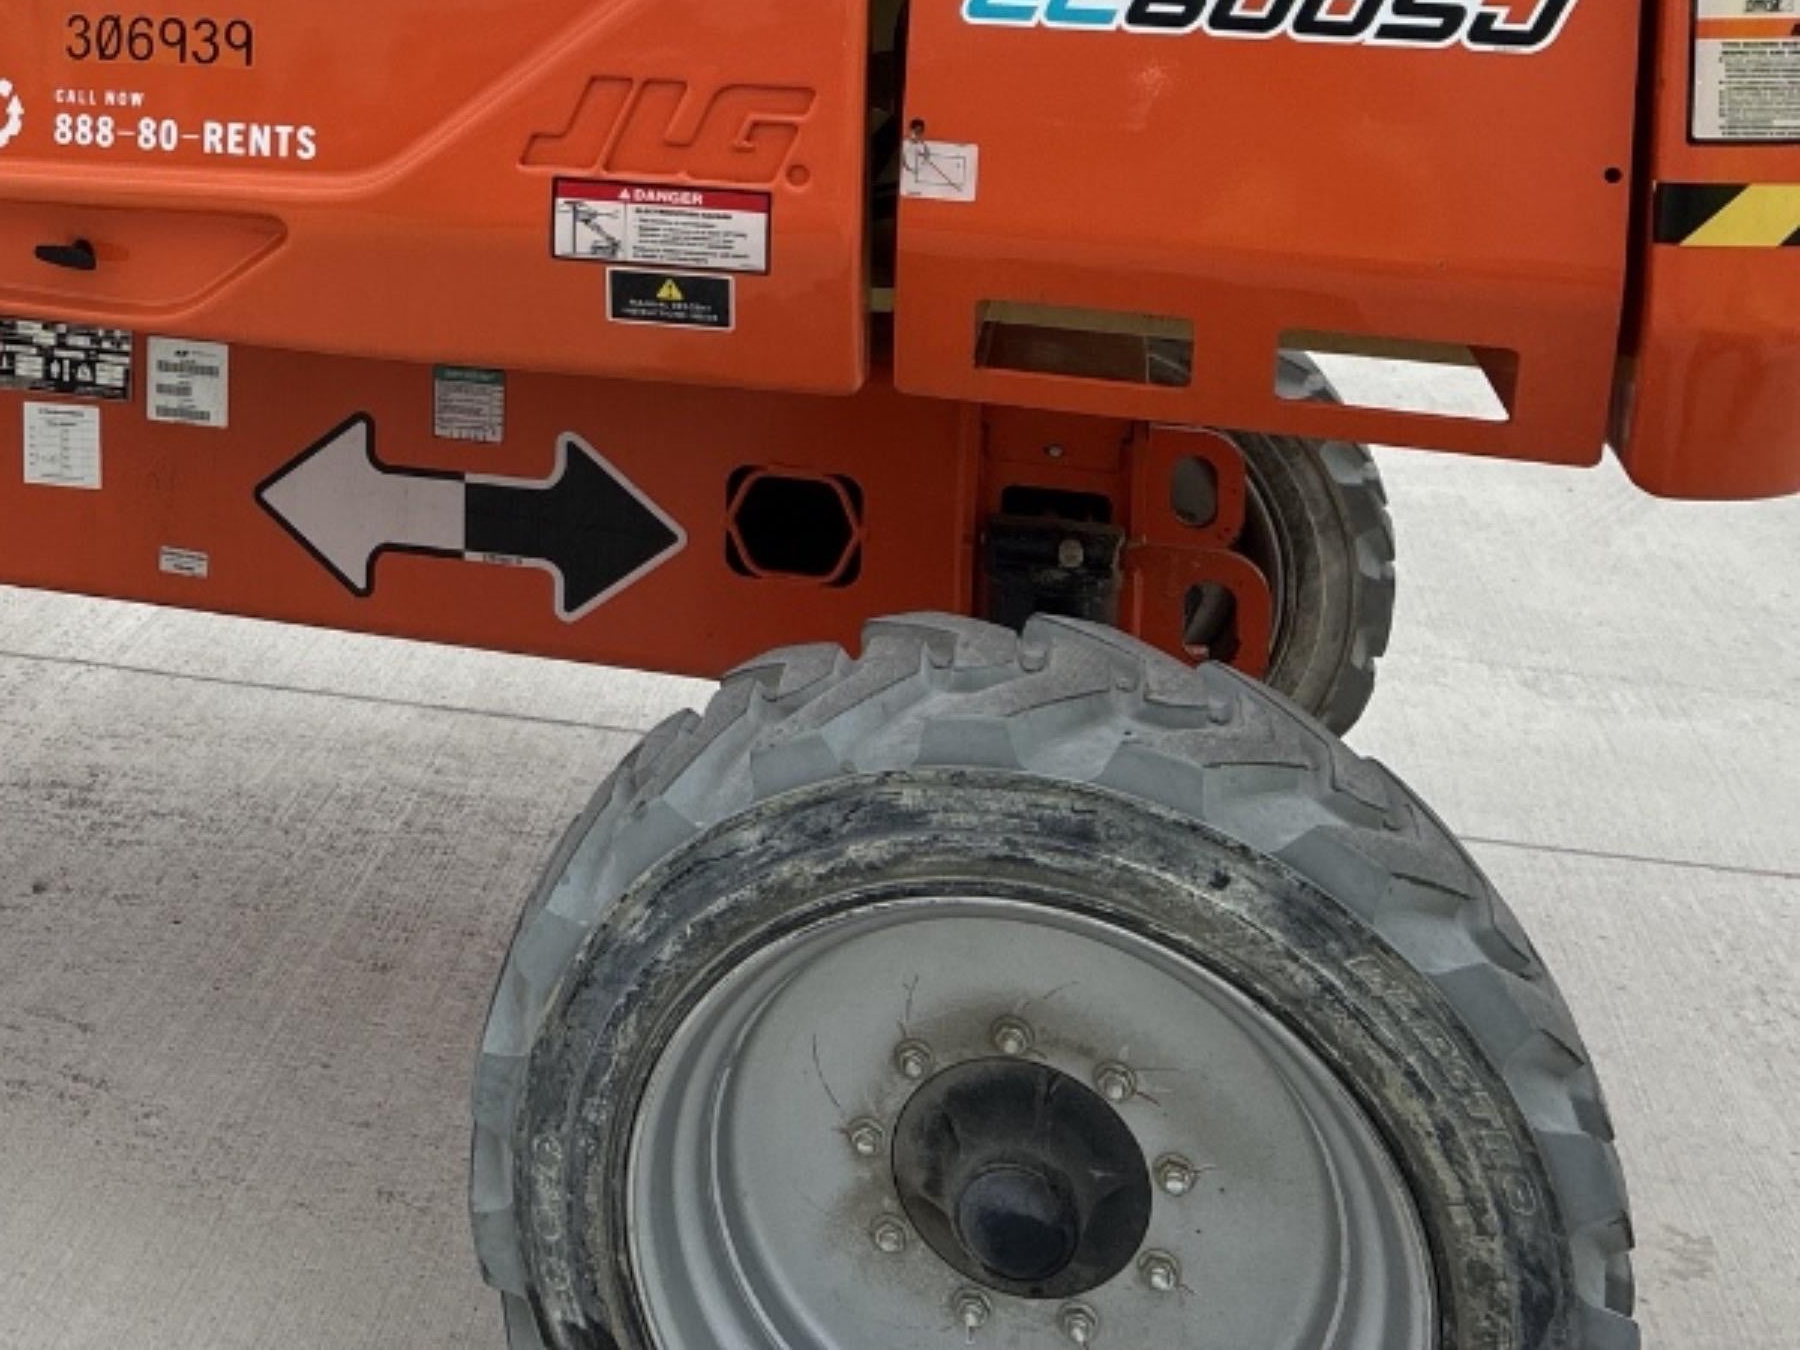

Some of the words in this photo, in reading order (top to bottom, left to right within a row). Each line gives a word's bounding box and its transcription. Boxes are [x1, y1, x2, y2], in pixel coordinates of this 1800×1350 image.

[66, 14, 254, 66] 306939
[56, 88, 97, 106] CALL
[104, 90, 145, 107] NOW
[53, 113, 317, 160] 888-80-RENTS
[633, 189, 703, 206] DANGER
